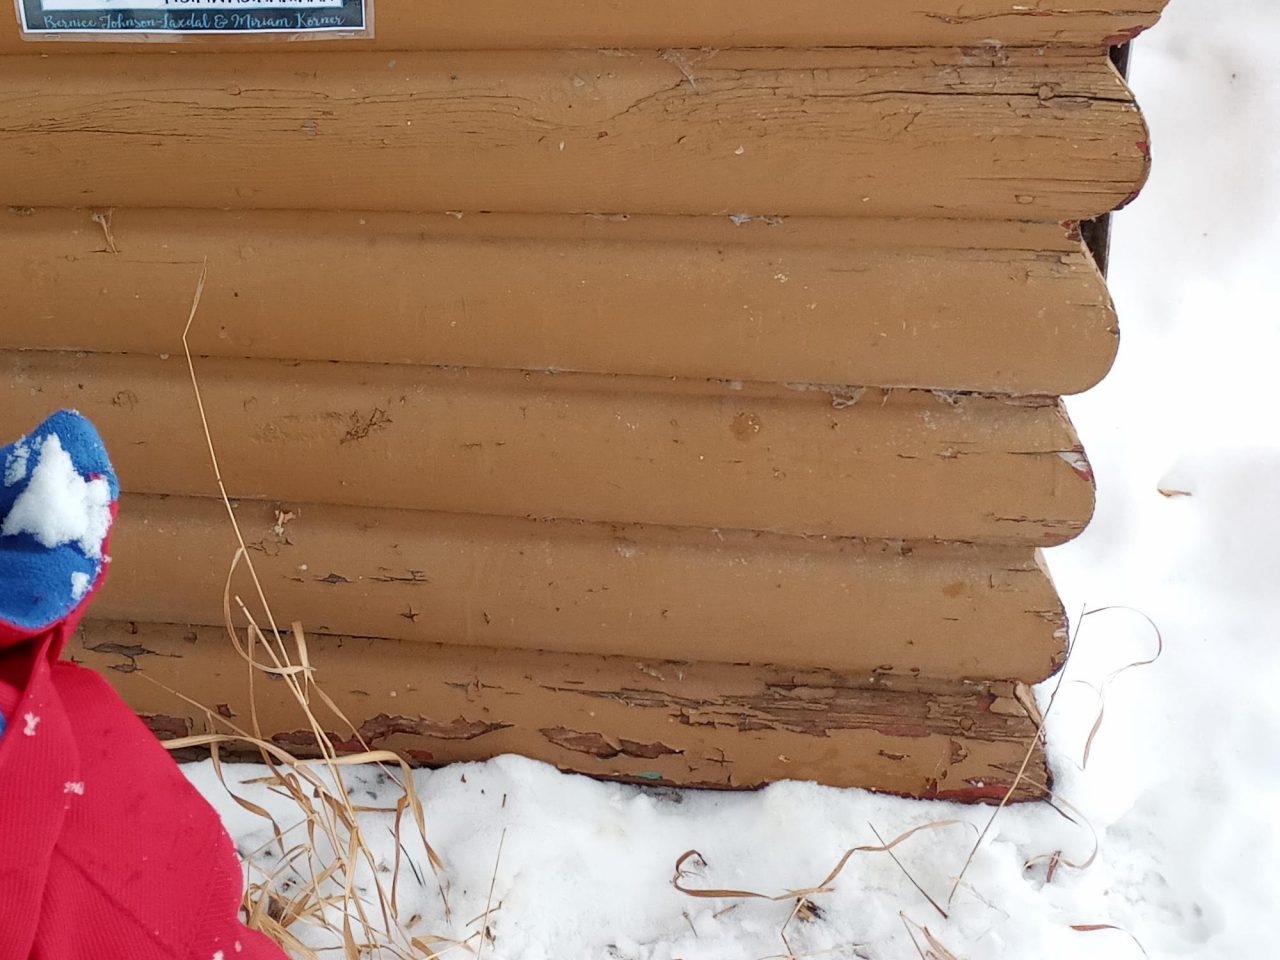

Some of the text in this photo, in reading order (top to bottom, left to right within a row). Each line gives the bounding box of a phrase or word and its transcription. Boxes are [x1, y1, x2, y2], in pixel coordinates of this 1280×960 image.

[44, 15, 96, 28] Bernice
[98, 13, 210, 29] Johnson-Laxdal
[214, 16, 228, 28] &
[231, 14, 292, 28] Miriam
